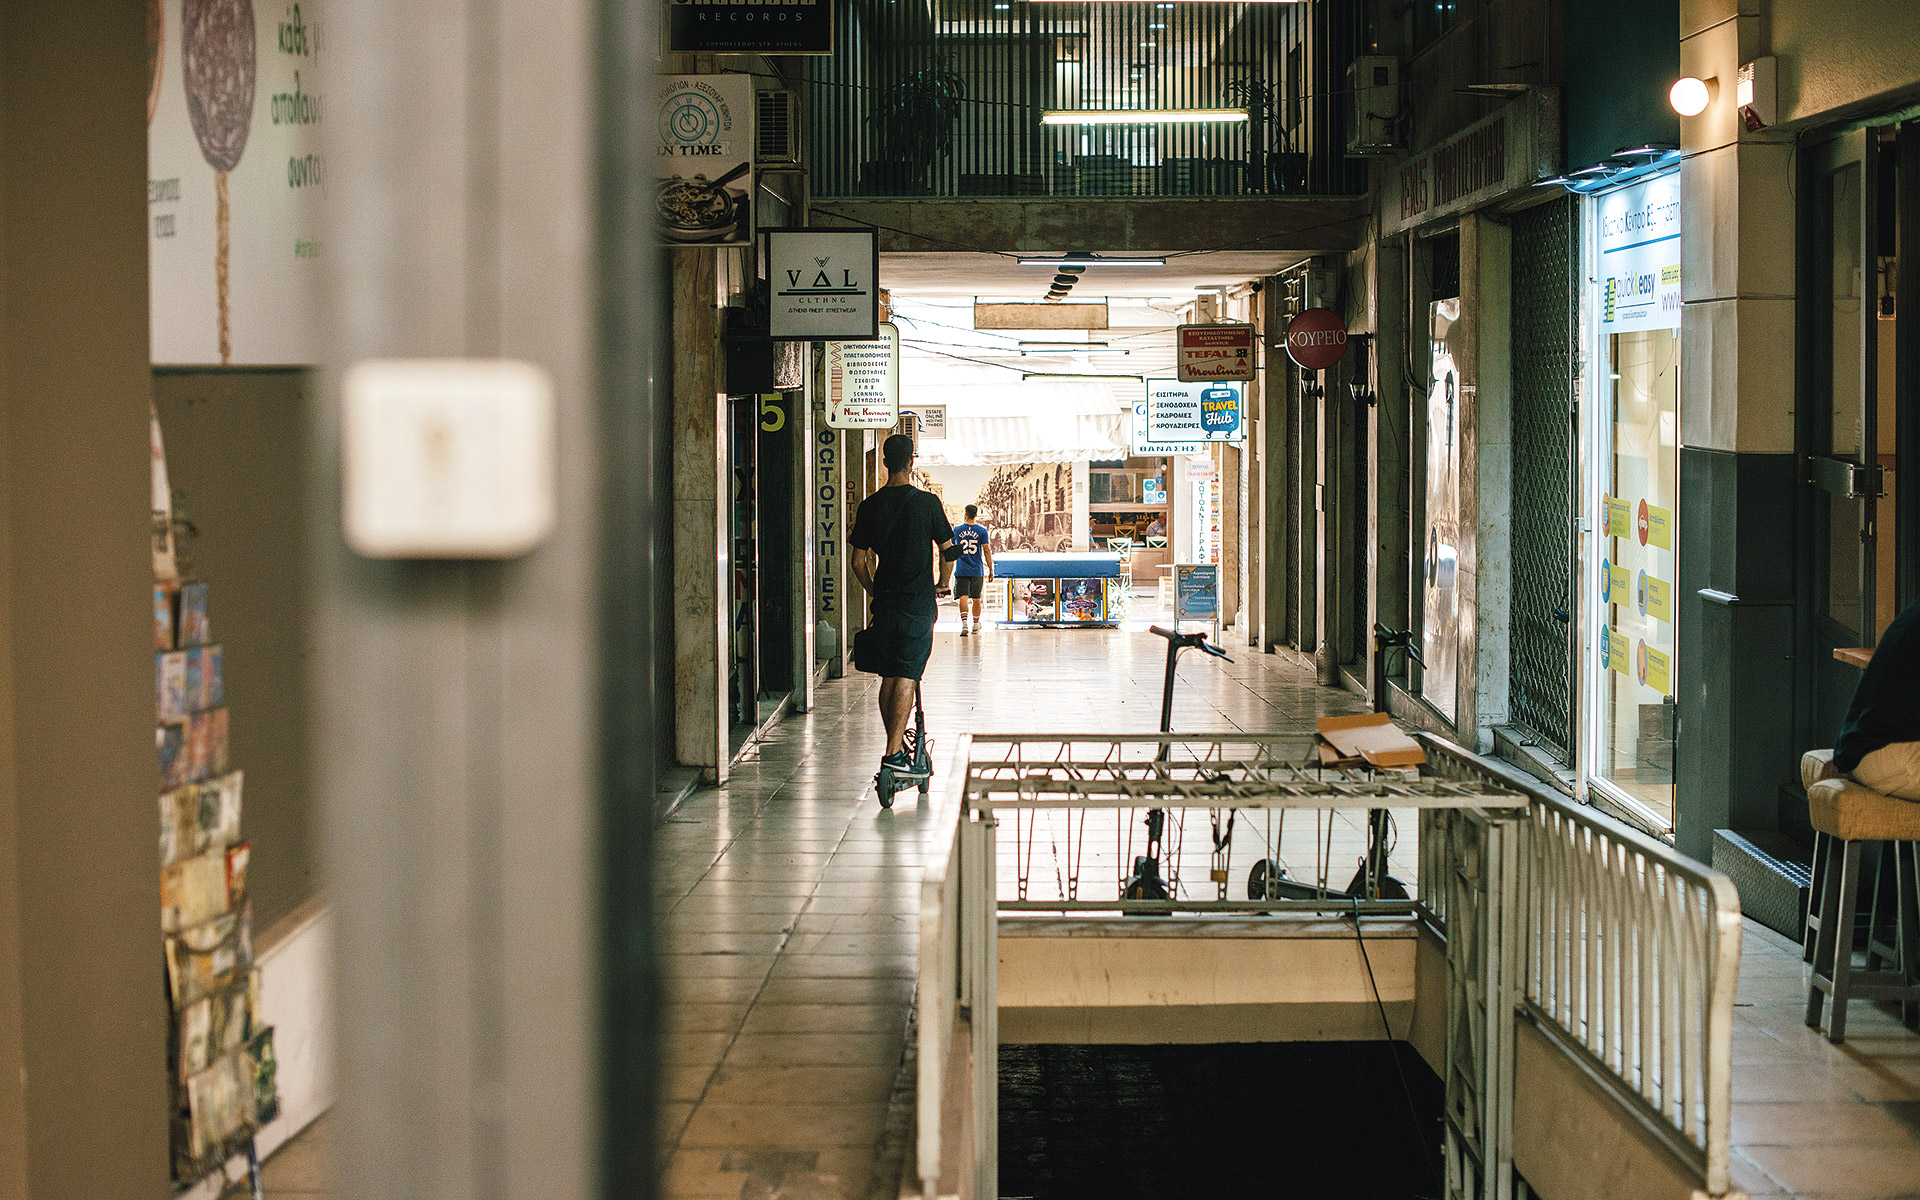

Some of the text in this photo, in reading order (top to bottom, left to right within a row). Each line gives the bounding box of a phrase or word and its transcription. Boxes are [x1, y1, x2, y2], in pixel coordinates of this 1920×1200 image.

[699, 13, 803, 21] RECORDS
[657, 144, 722, 156] IN TIME
[1288, 329, 1347, 347] ΚΟΥΡΕΙΟ
[1185, 350, 1232, 358] TEFAL
[1185, 364, 1250, 376] Moulinex
[761, 393, 786, 432] 5
[1202, 400, 1239, 412] TRAVEL
[1205, 410, 1234, 426] Hub
[818, 430, 836, 612] ΦΩΤΟΤΥΠΙΕΣ
[959, 539, 979, 555] 25
